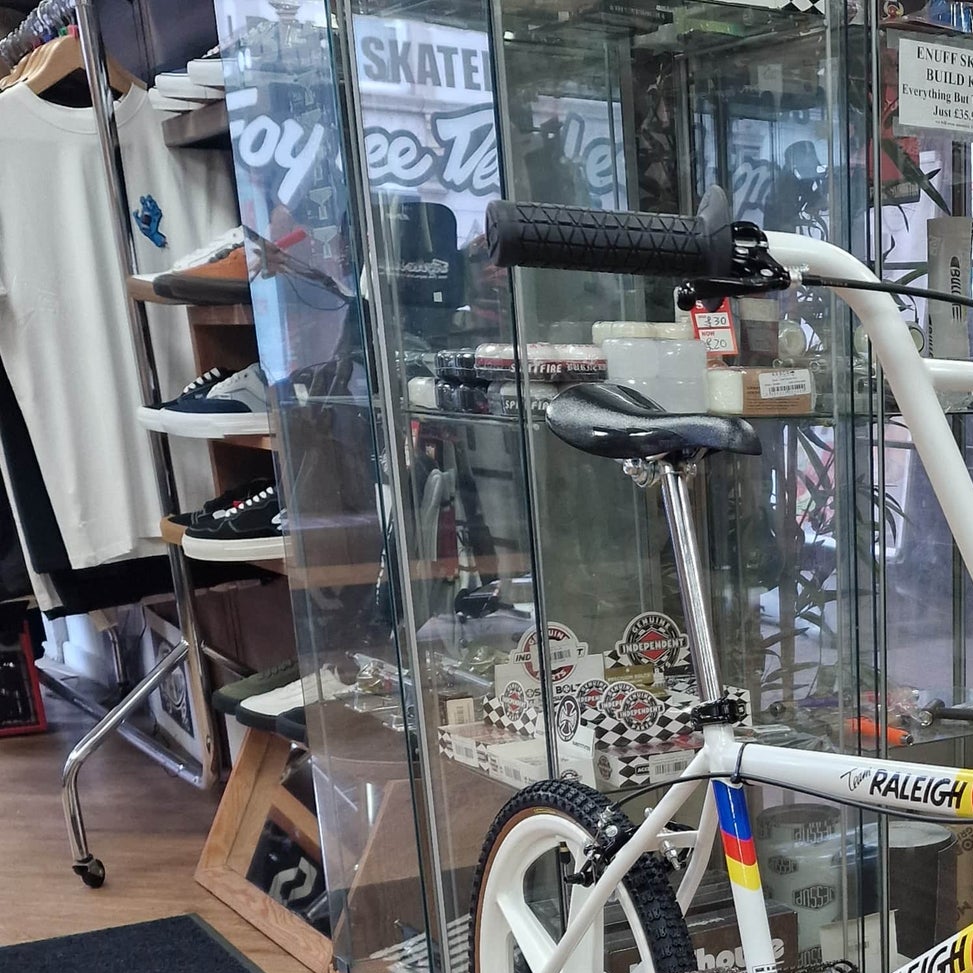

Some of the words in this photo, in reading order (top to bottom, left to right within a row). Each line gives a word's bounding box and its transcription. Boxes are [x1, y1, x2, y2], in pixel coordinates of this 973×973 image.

[360, 36, 491, 92] SKATE
[917, 46, 958, 66] ENUFF
[926, 69, 965, 87] BUILD
[902, 84, 952, 104] Everything
[953, 94, 969, 105] But
[933, 106, 951, 119] Just
[632, 615, 671, 634] GENUINE
[621, 638, 685, 653] INDEPENDENT
[840, 767, 872, 792] Team
[869, 769, 968, 809] RALEIGH
[794, 885, 834, 908] JESSUP
